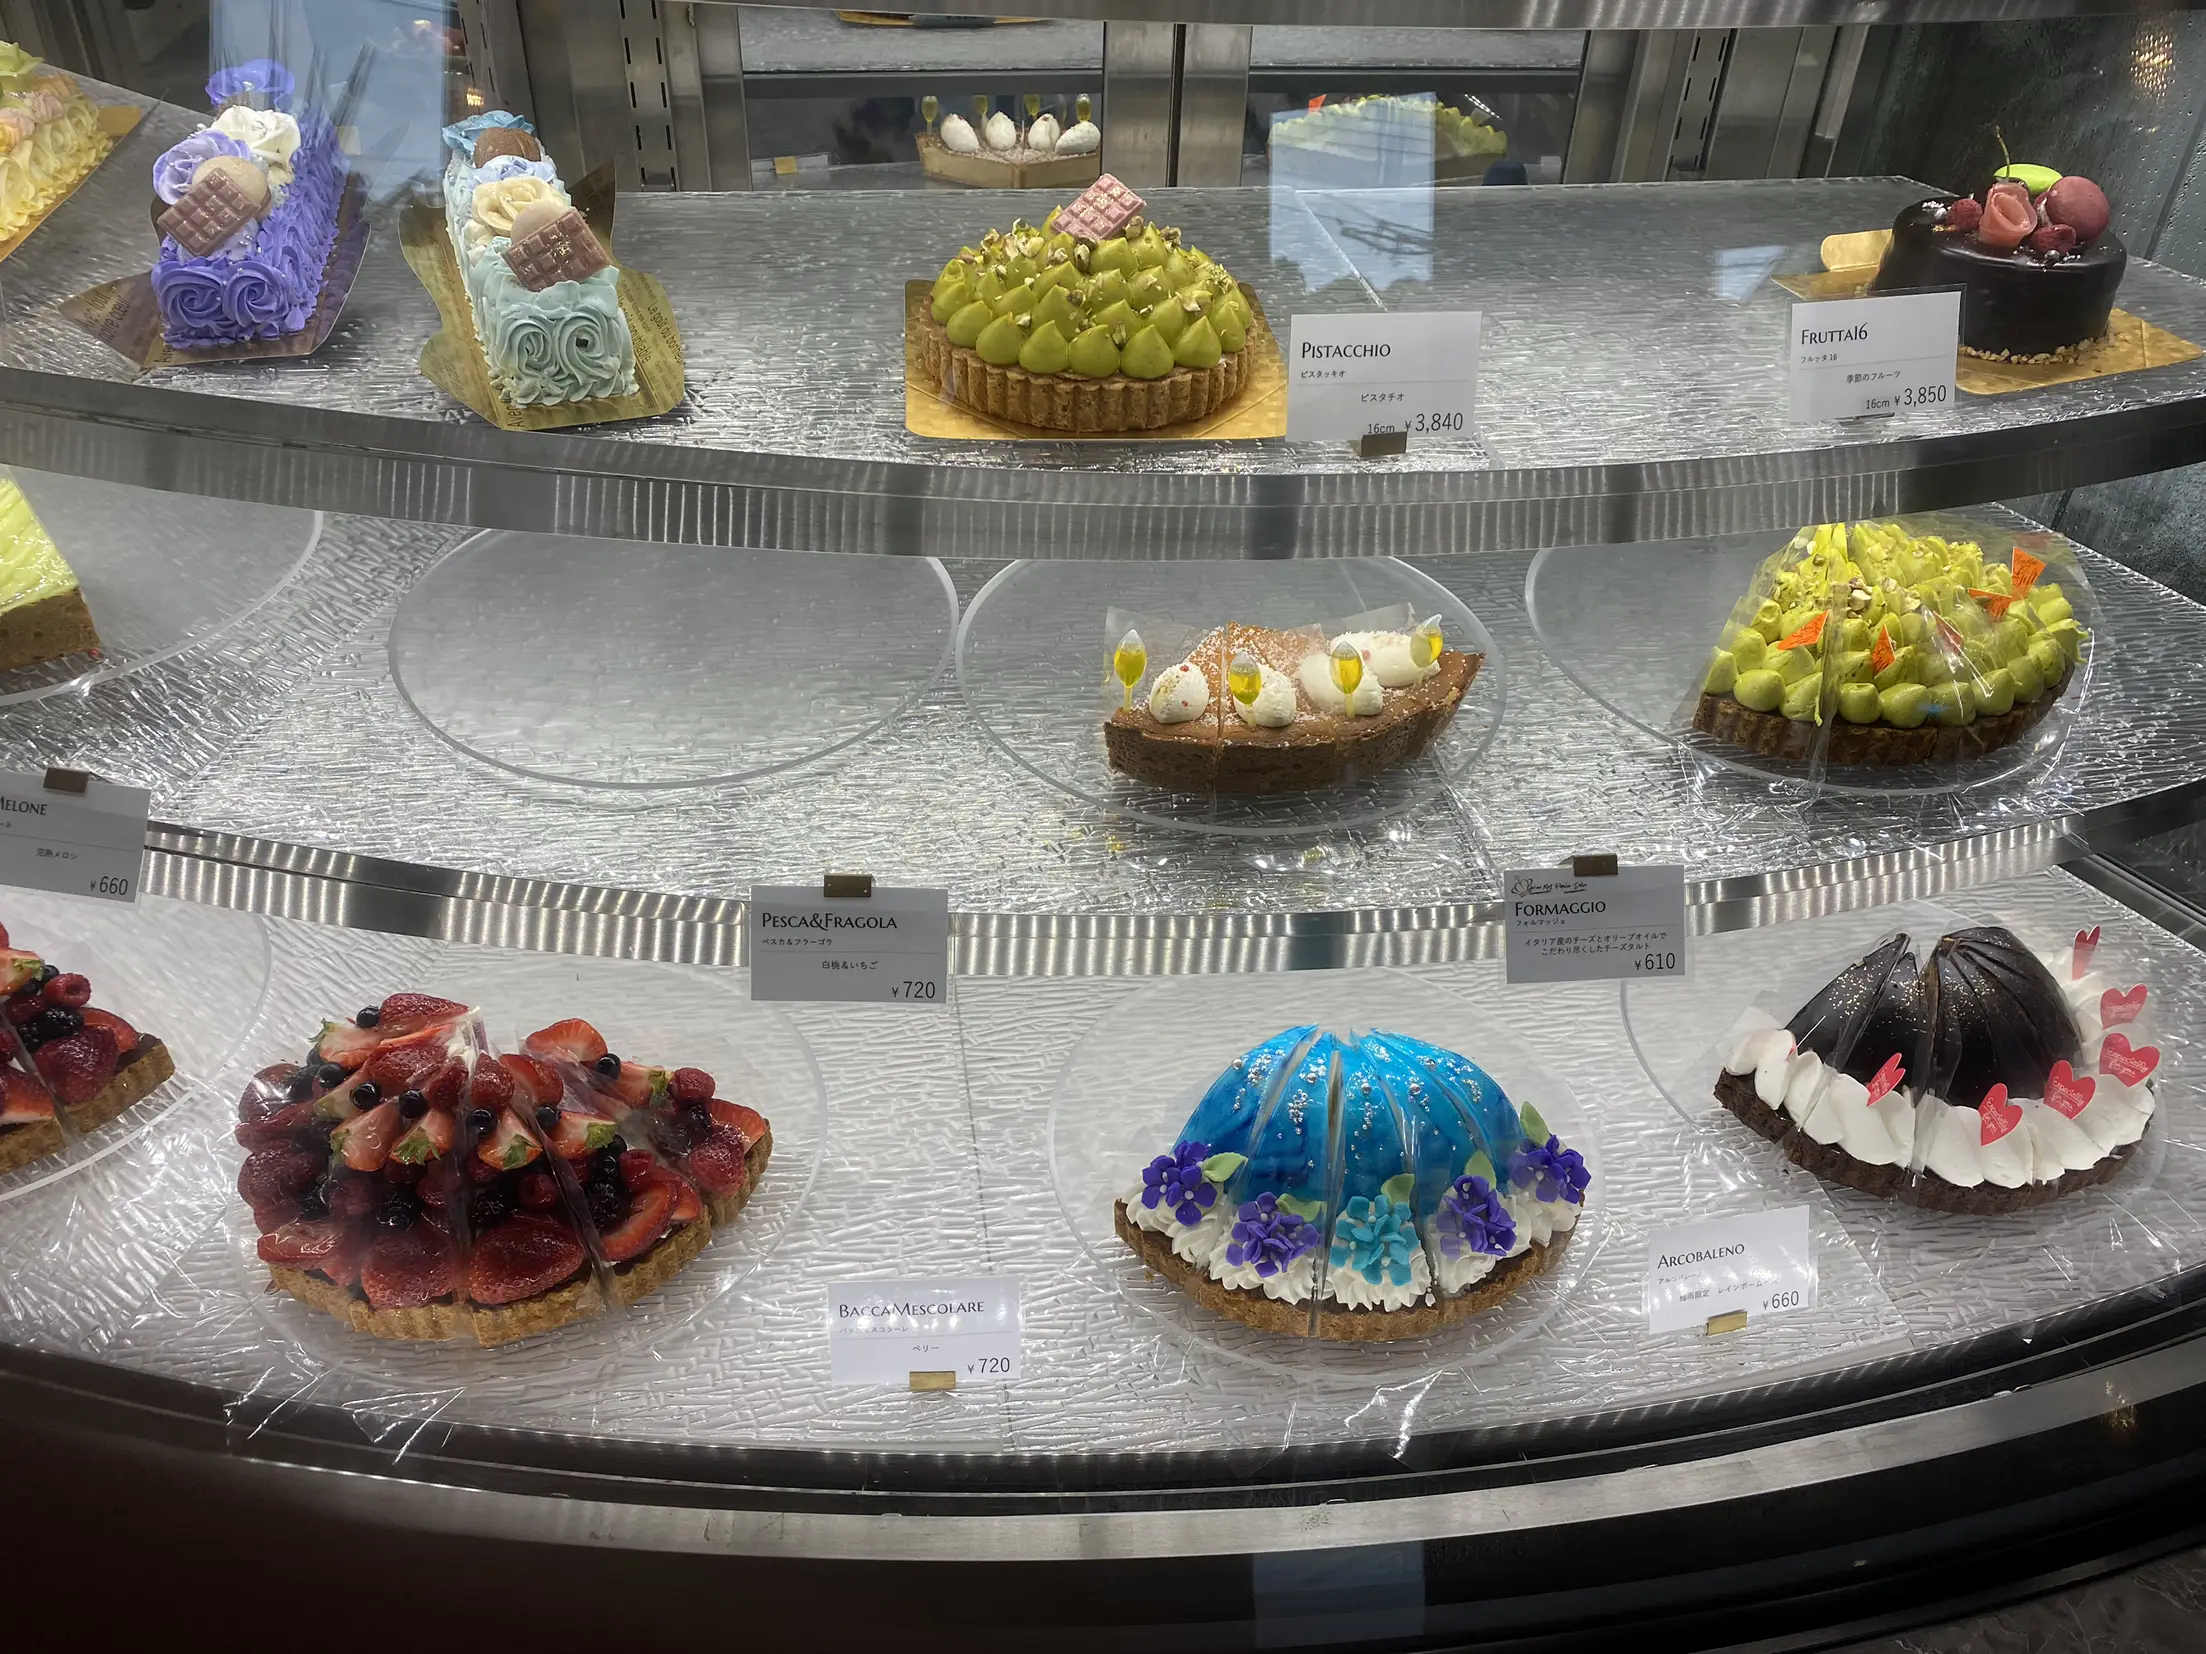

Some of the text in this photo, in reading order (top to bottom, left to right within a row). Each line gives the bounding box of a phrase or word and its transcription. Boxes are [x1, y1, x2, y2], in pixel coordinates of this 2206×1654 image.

[648, 301, 658, 317] Le
[661, 324, 672, 339] du
[1302, 342, 1391, 358] PISTACCHIO
[1847, 371, 1901, 384] 季節のフルーツ
[1361, 393, 1405, 402] ピスタチオ
[1866, 399, 1890, 409] 16cm
[1367, 423, 1395, 434] 16cm
[1515, 901, 1606, 916] FORMAGGIO
[762, 912, 898, 931] PESCA&FRAGOLA
[1657, 1243, 1745, 1269] ARCOBALENO
